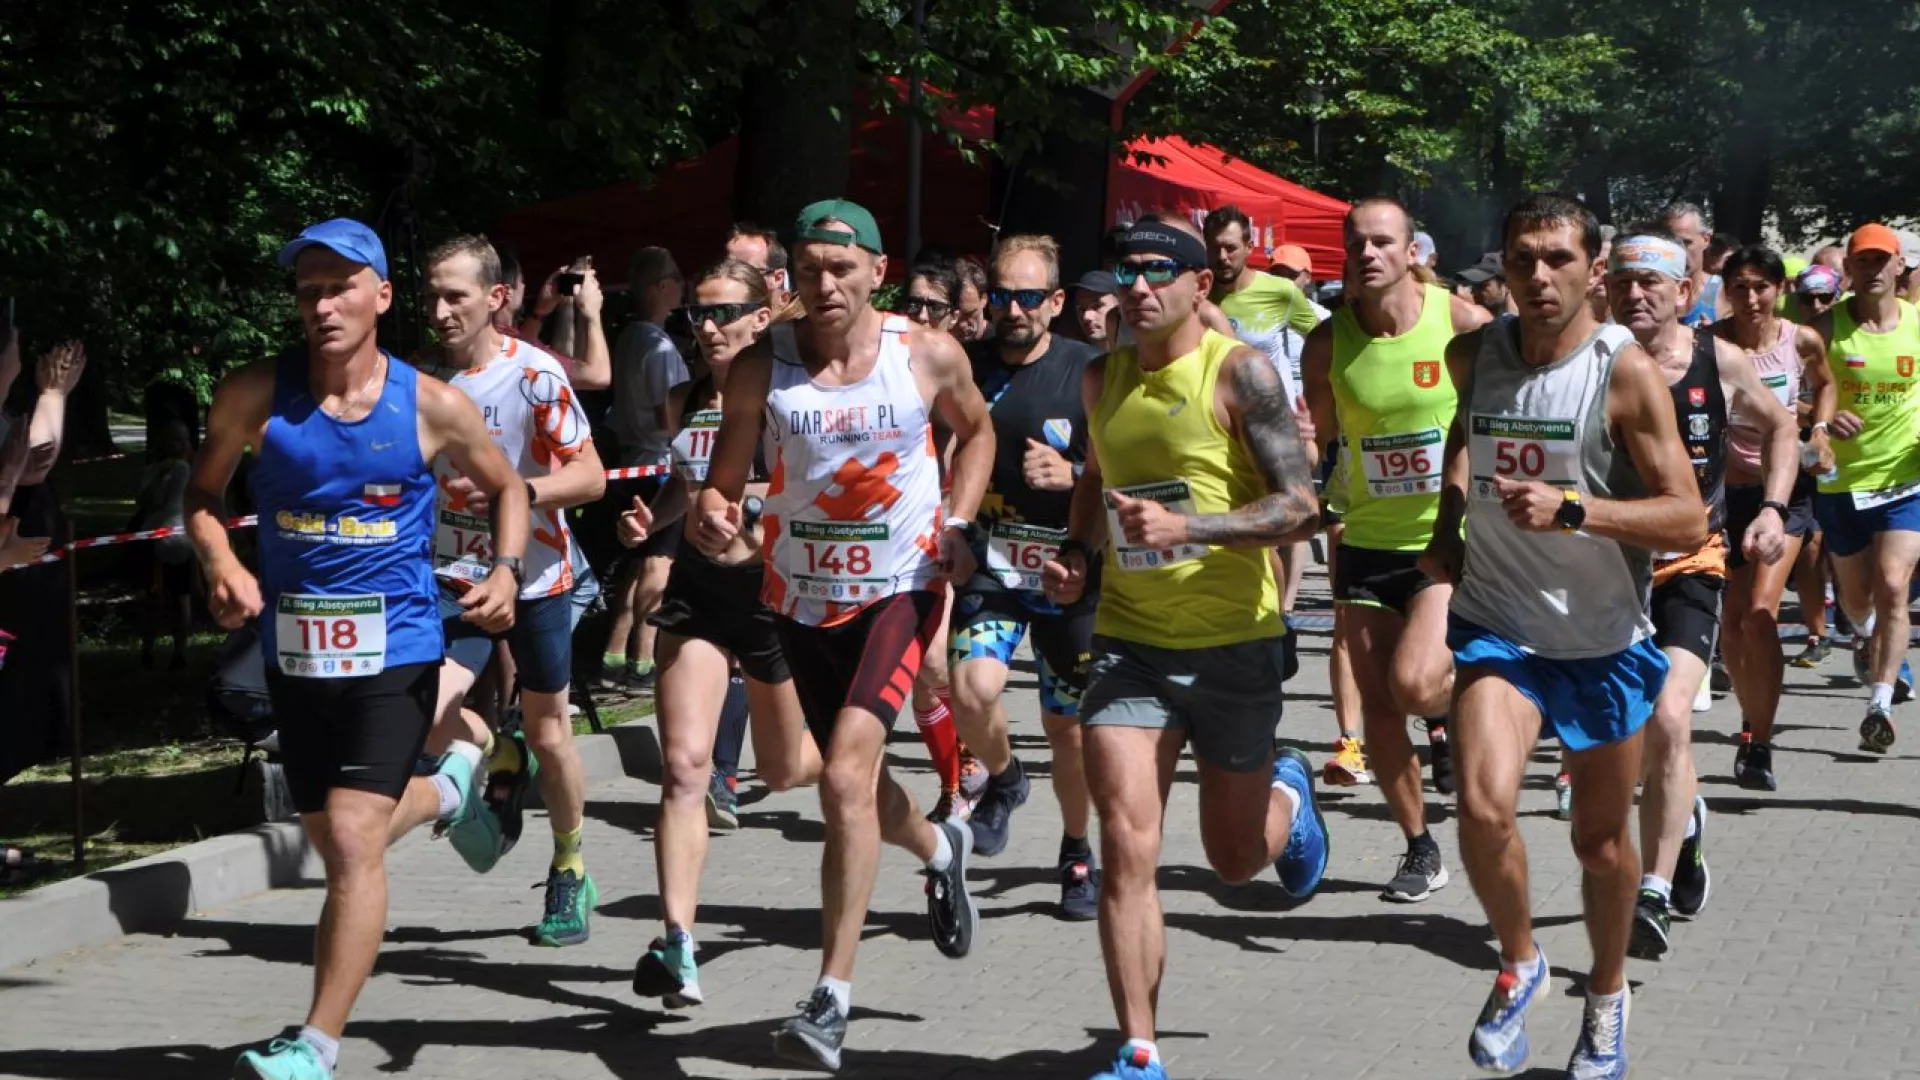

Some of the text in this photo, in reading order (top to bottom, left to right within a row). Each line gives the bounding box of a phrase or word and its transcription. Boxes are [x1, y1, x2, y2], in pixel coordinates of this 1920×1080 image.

[484, 405, 501, 427] PL
[790, 403, 899, 435] DARSOFT.PL
[1489, 418, 1509, 432] Bieg
[1511, 421, 1572, 434] Abstynenta
[820, 430, 903, 445] RUNNING TEAM
[1372, 438, 1391, 448] Bieg
[1392, 430, 1438, 445] Abstynenta
[1374, 448, 1431, 477] 196
[1495, 440, 1545, 477] 50
[804, 524, 825, 535] Bieg
[827, 526, 885, 536] Abstynenta
[1009, 527, 1028, 538] Bieg
[453, 529, 493, 562] 14
[803, 542, 872, 576] 148
[293, 598, 315, 611] Bieg
[318, 599, 378, 611] Abstynenta
[296, 618, 358, 650] 118
